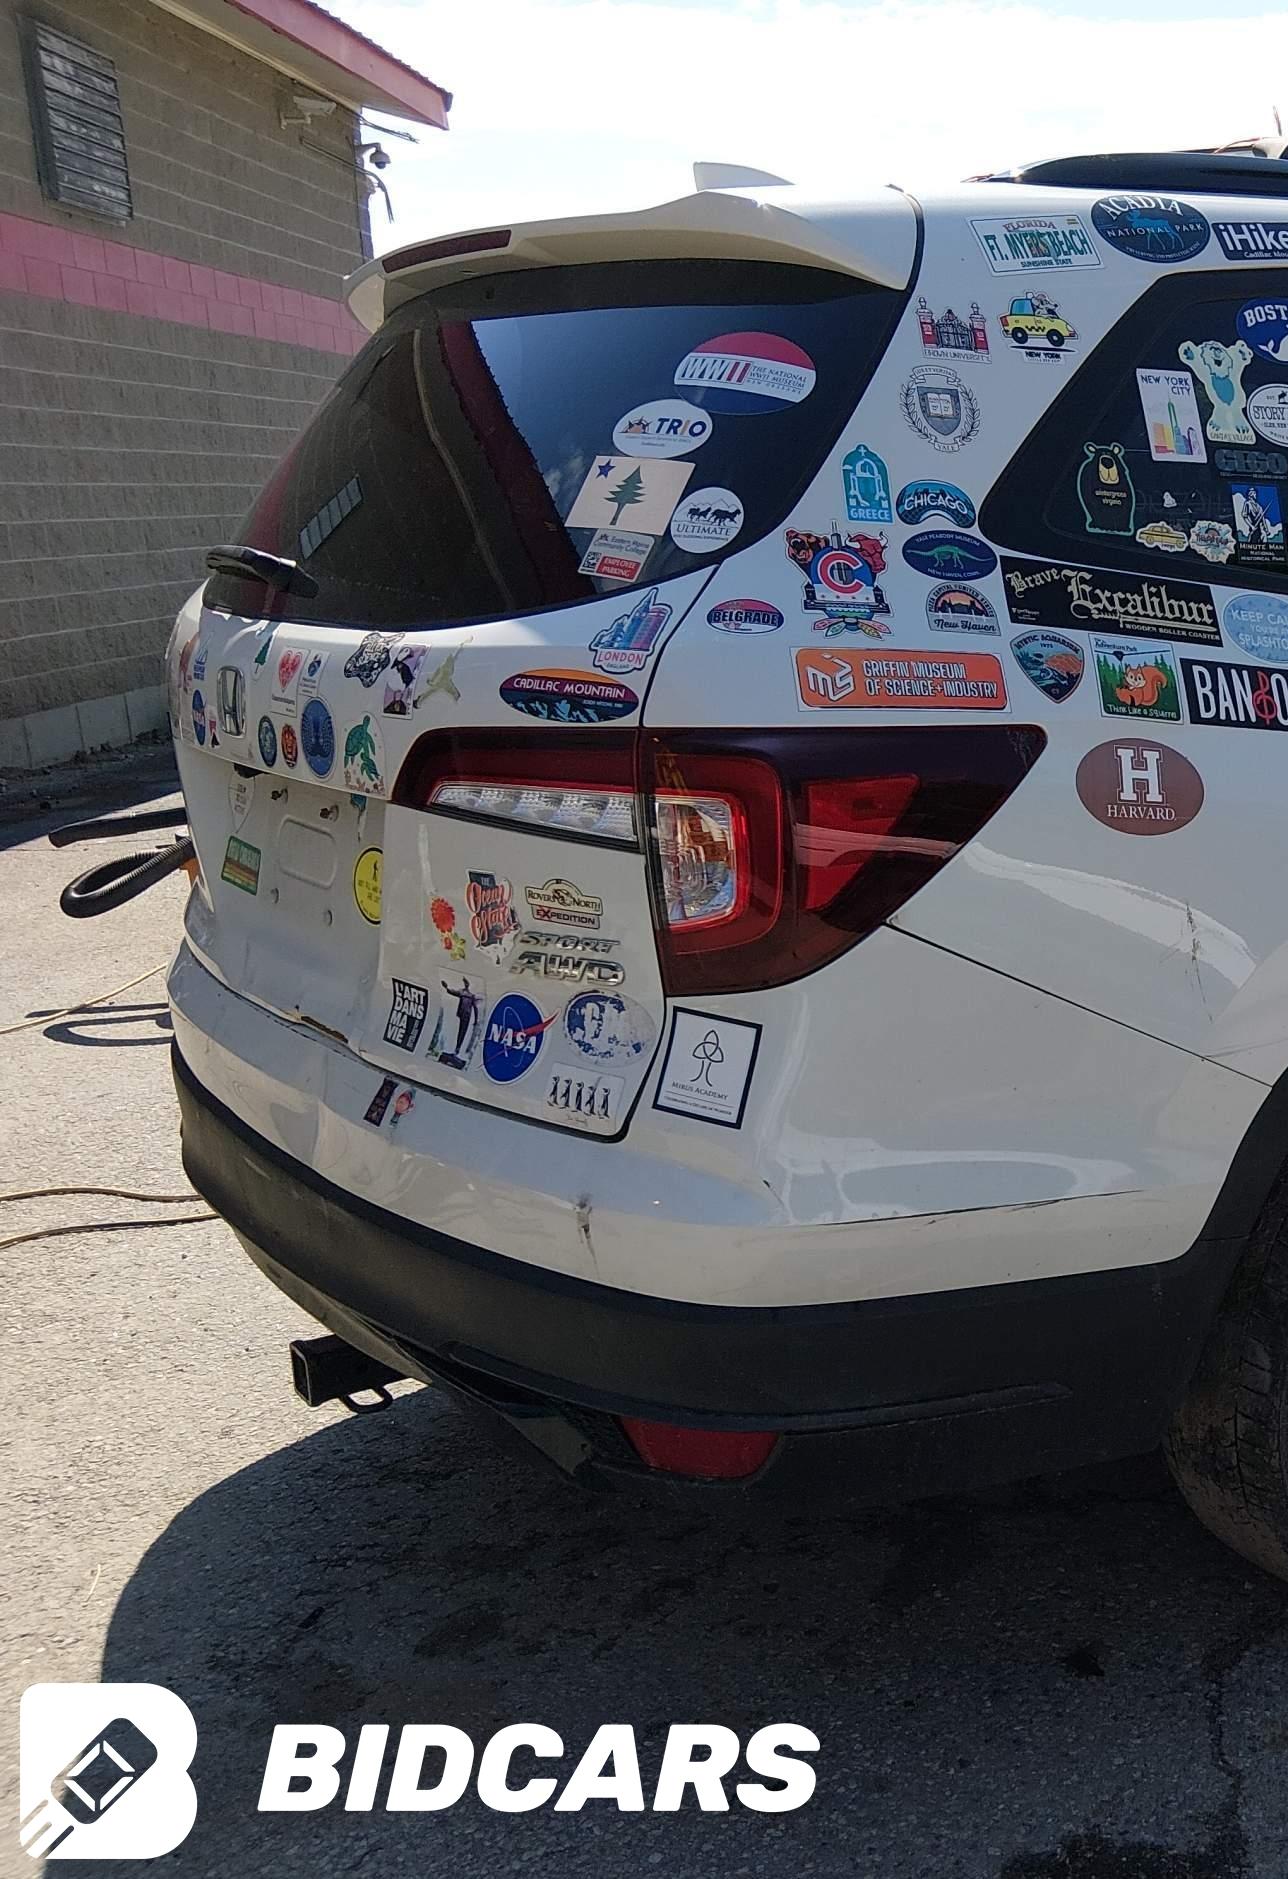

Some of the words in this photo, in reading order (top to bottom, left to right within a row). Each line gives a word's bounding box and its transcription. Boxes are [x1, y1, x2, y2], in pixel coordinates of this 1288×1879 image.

[1099, 195, 1183, 220] ACADIA
[1002, 219, 1057, 232] FLORIDA
[1106, 226, 1170, 238] NATIONAL
[1174, 223, 1205, 232] PARK
[1003, 231, 1050, 260] MYERS
[1049, 229, 1093, 259] BEACH
[1055, 258, 1073, 266] STATE
[1140, 375, 1162, 386] NEW
[1164, 376, 1189, 387] YORK
[1171, 386, 1191, 396] CITY
[1253, 405, 1285, 420] STORY
[656, 417, 707, 437] TRIO
[904, 493, 968, 515] CHICAGO
[850, 508, 891, 521] GREECE
[677, 524, 730, 536] ULTIMATE
[1005, 567, 1061, 598] Brave
[1060, 568, 1215, 624] Excalibur
[712, 610, 779, 626] BELGRADE
[1231, 609, 1263, 622] KEEP
[934, 618, 959, 630] New
[960, 620, 998, 632] Haven
[1188, 630, 1221, 641] COASTER
[598, 650, 643, 666] LONDON
[863, 659, 910, 678] GRIFFIN
[912, 660, 966, 680] MUSEUM
[513, 677, 560, 692] CADILLAC
[563, 683, 625, 699] MOUNTAIN
[865, 679, 883, 697] OF
[1114, 745, 1165, 805] H
[1107, 804, 1176, 820] HARVARD
[536, 907, 596, 926] EXPEDITION
[509, 951, 626, 987] AWD
[394, 981, 426, 1005] L'ART
[393, 996, 425, 1020] DANS
[389, 1010, 408, 1029] MA
[386, 1023, 406, 1043] VIE
[488, 1022, 538, 1054] NASA
[695, 1086, 728, 1100] ACADEMY
